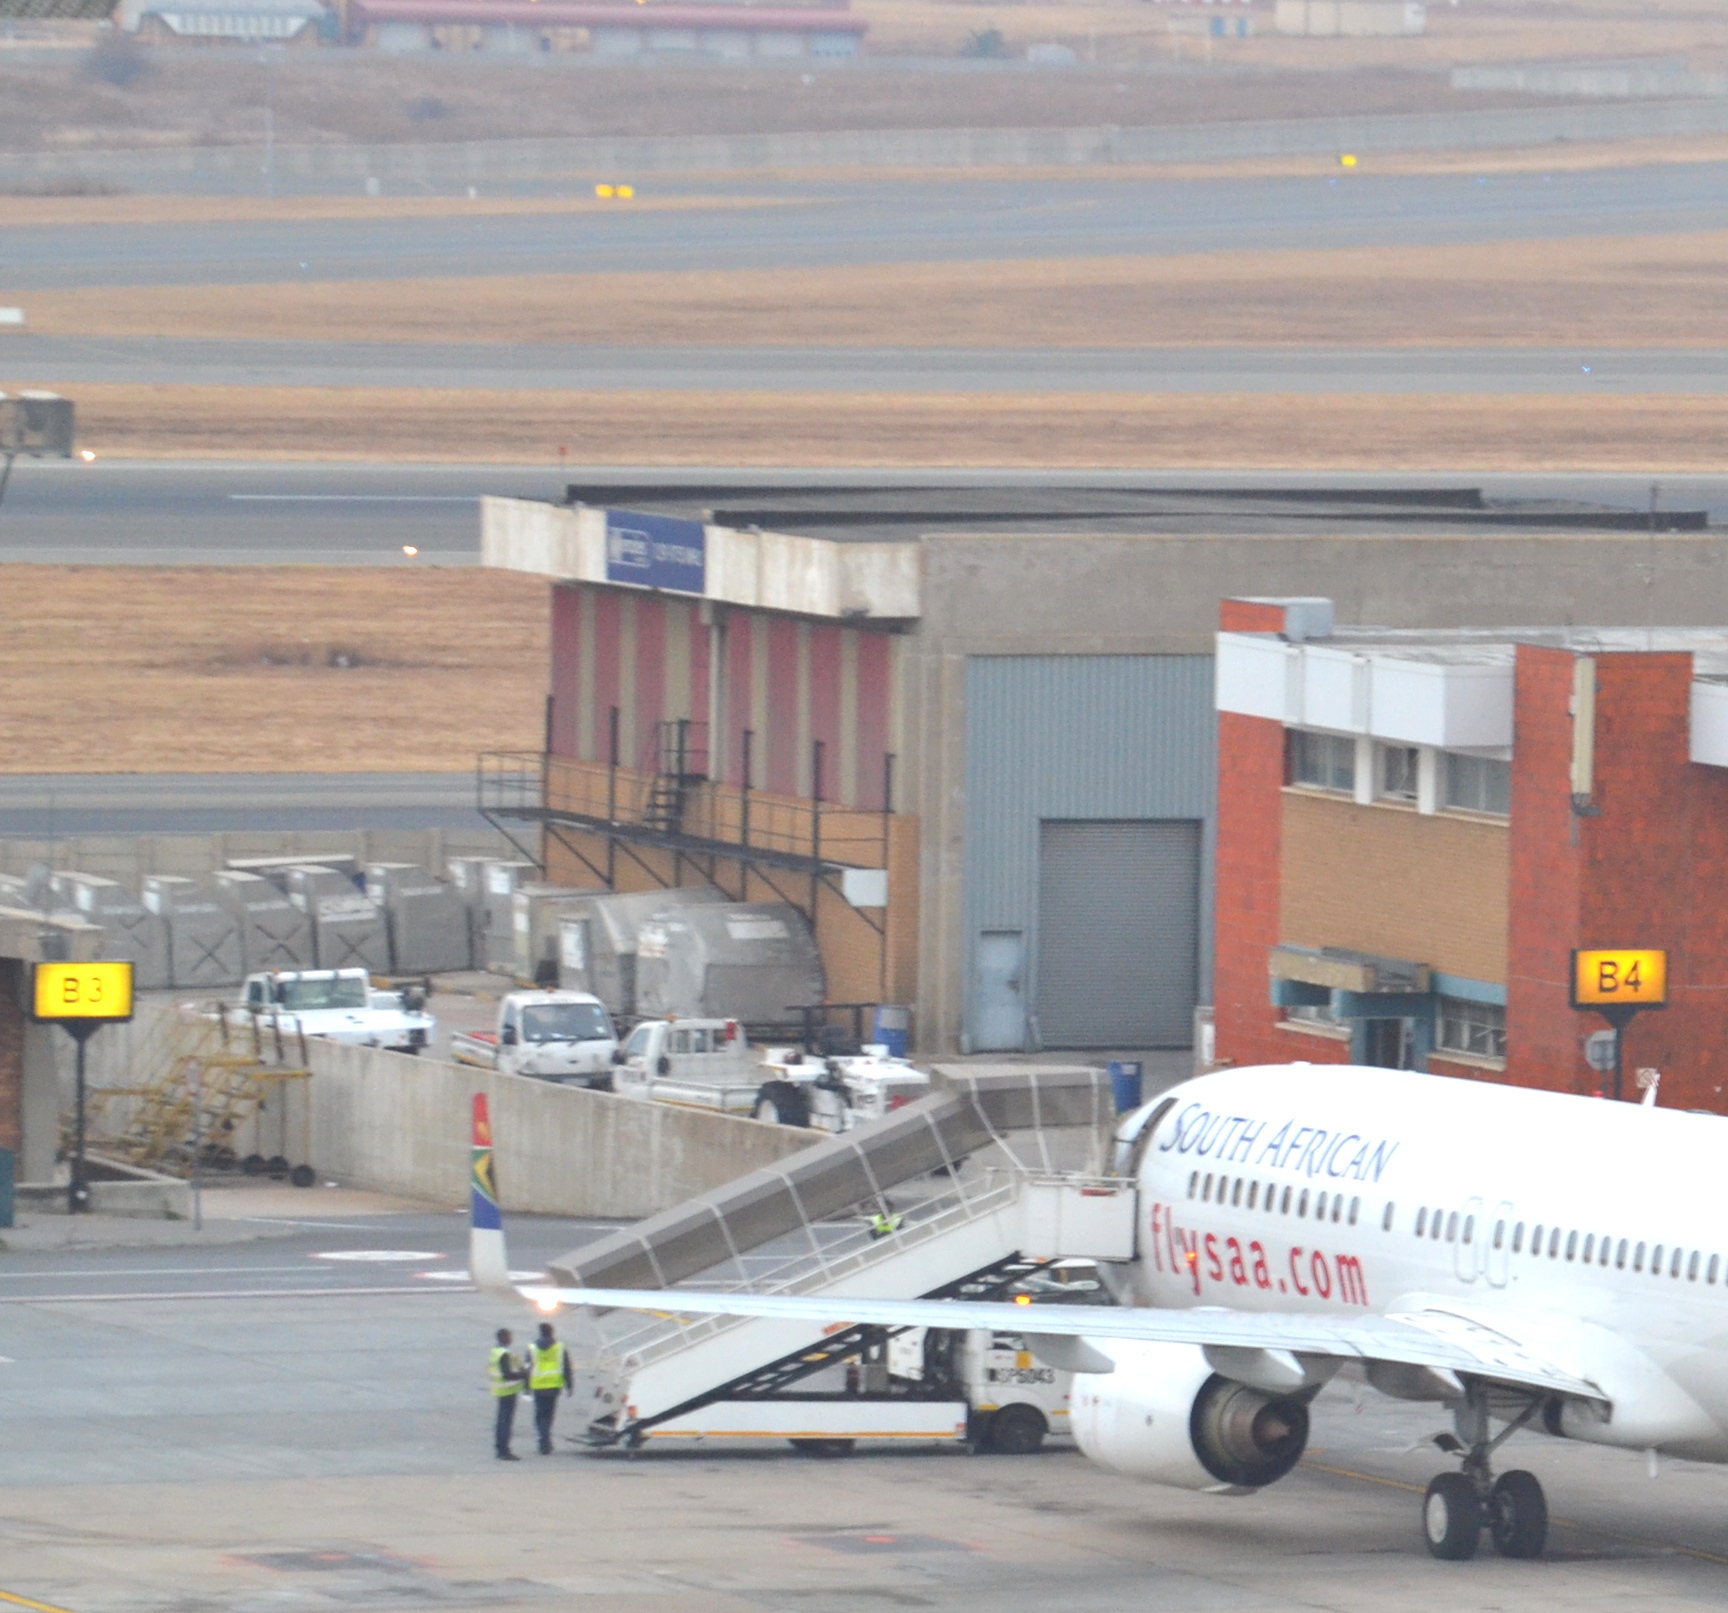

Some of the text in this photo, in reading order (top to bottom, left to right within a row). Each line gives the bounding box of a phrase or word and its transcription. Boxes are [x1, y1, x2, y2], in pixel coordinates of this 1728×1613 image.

[1599, 961, 1641, 992] B4
[1160, 1103, 1400, 1183] SOUTH AFRICAN
[1152, 1203, 1368, 1306] flysaa.com
